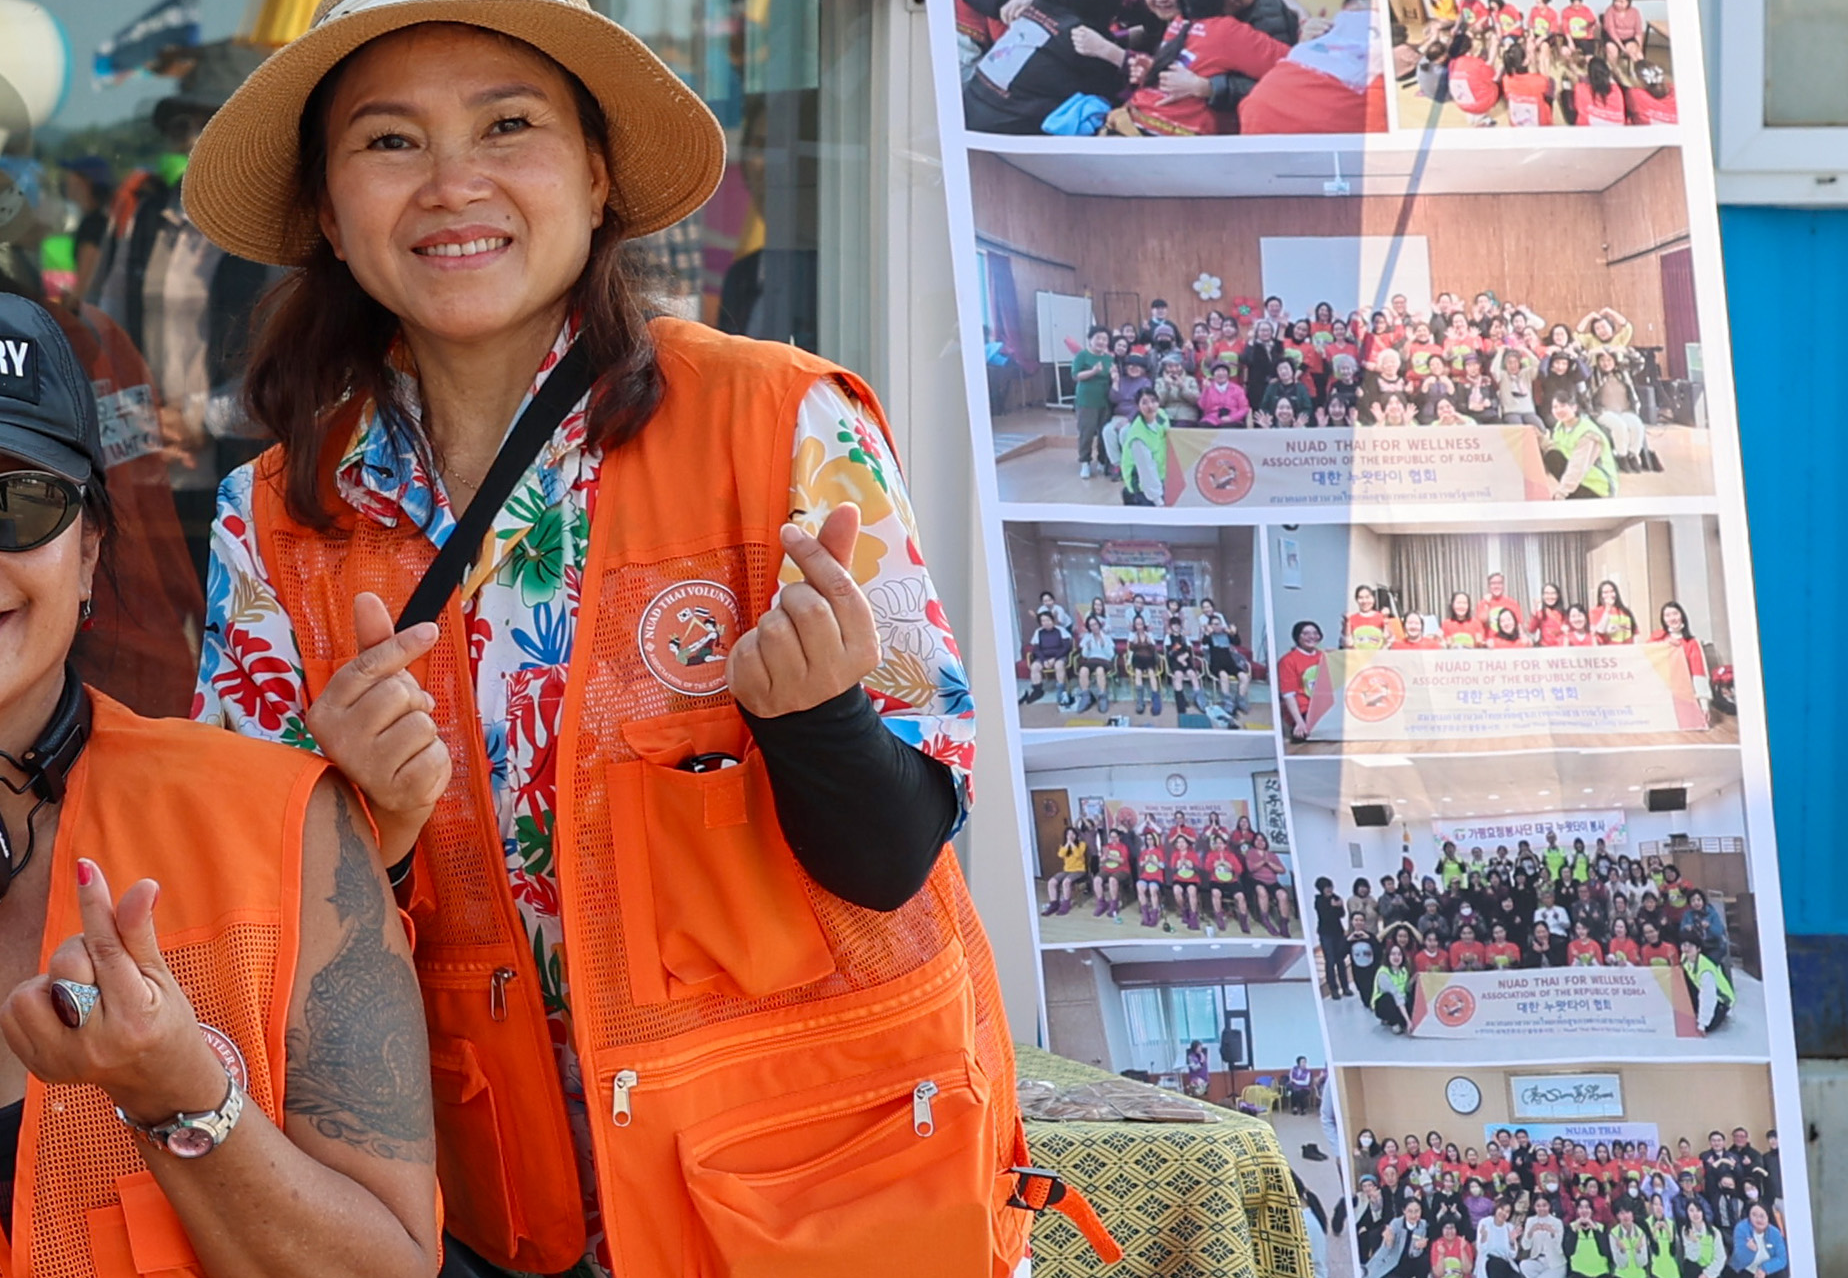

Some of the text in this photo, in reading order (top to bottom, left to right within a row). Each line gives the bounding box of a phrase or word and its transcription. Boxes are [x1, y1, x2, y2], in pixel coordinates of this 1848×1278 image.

[1286, 437, 1481, 453] NUAD THAI FOR WELLNESS
[1262, 453, 1494, 467] ASSOCIATION OF THE REPUBLIC OF KOREA
[1312, 470, 1341, 485] 대한
[645, 586, 739, 639] NUAD THAI VOLUNTEE
[1434, 657, 1618, 673] NUAD THAI FOR WELLNESS
[1412, 671, 1634, 687] ASSOCIATION OF THE REPUBLIC OF KOREA
[1498, 975, 1637, 988] NUAD THAI FOR WELLNESS
[1481, 990, 1536, 1000] ASSOCIATION
[1540, 989, 1550, 997] OF
[1555, 989, 1571, 997] THE
